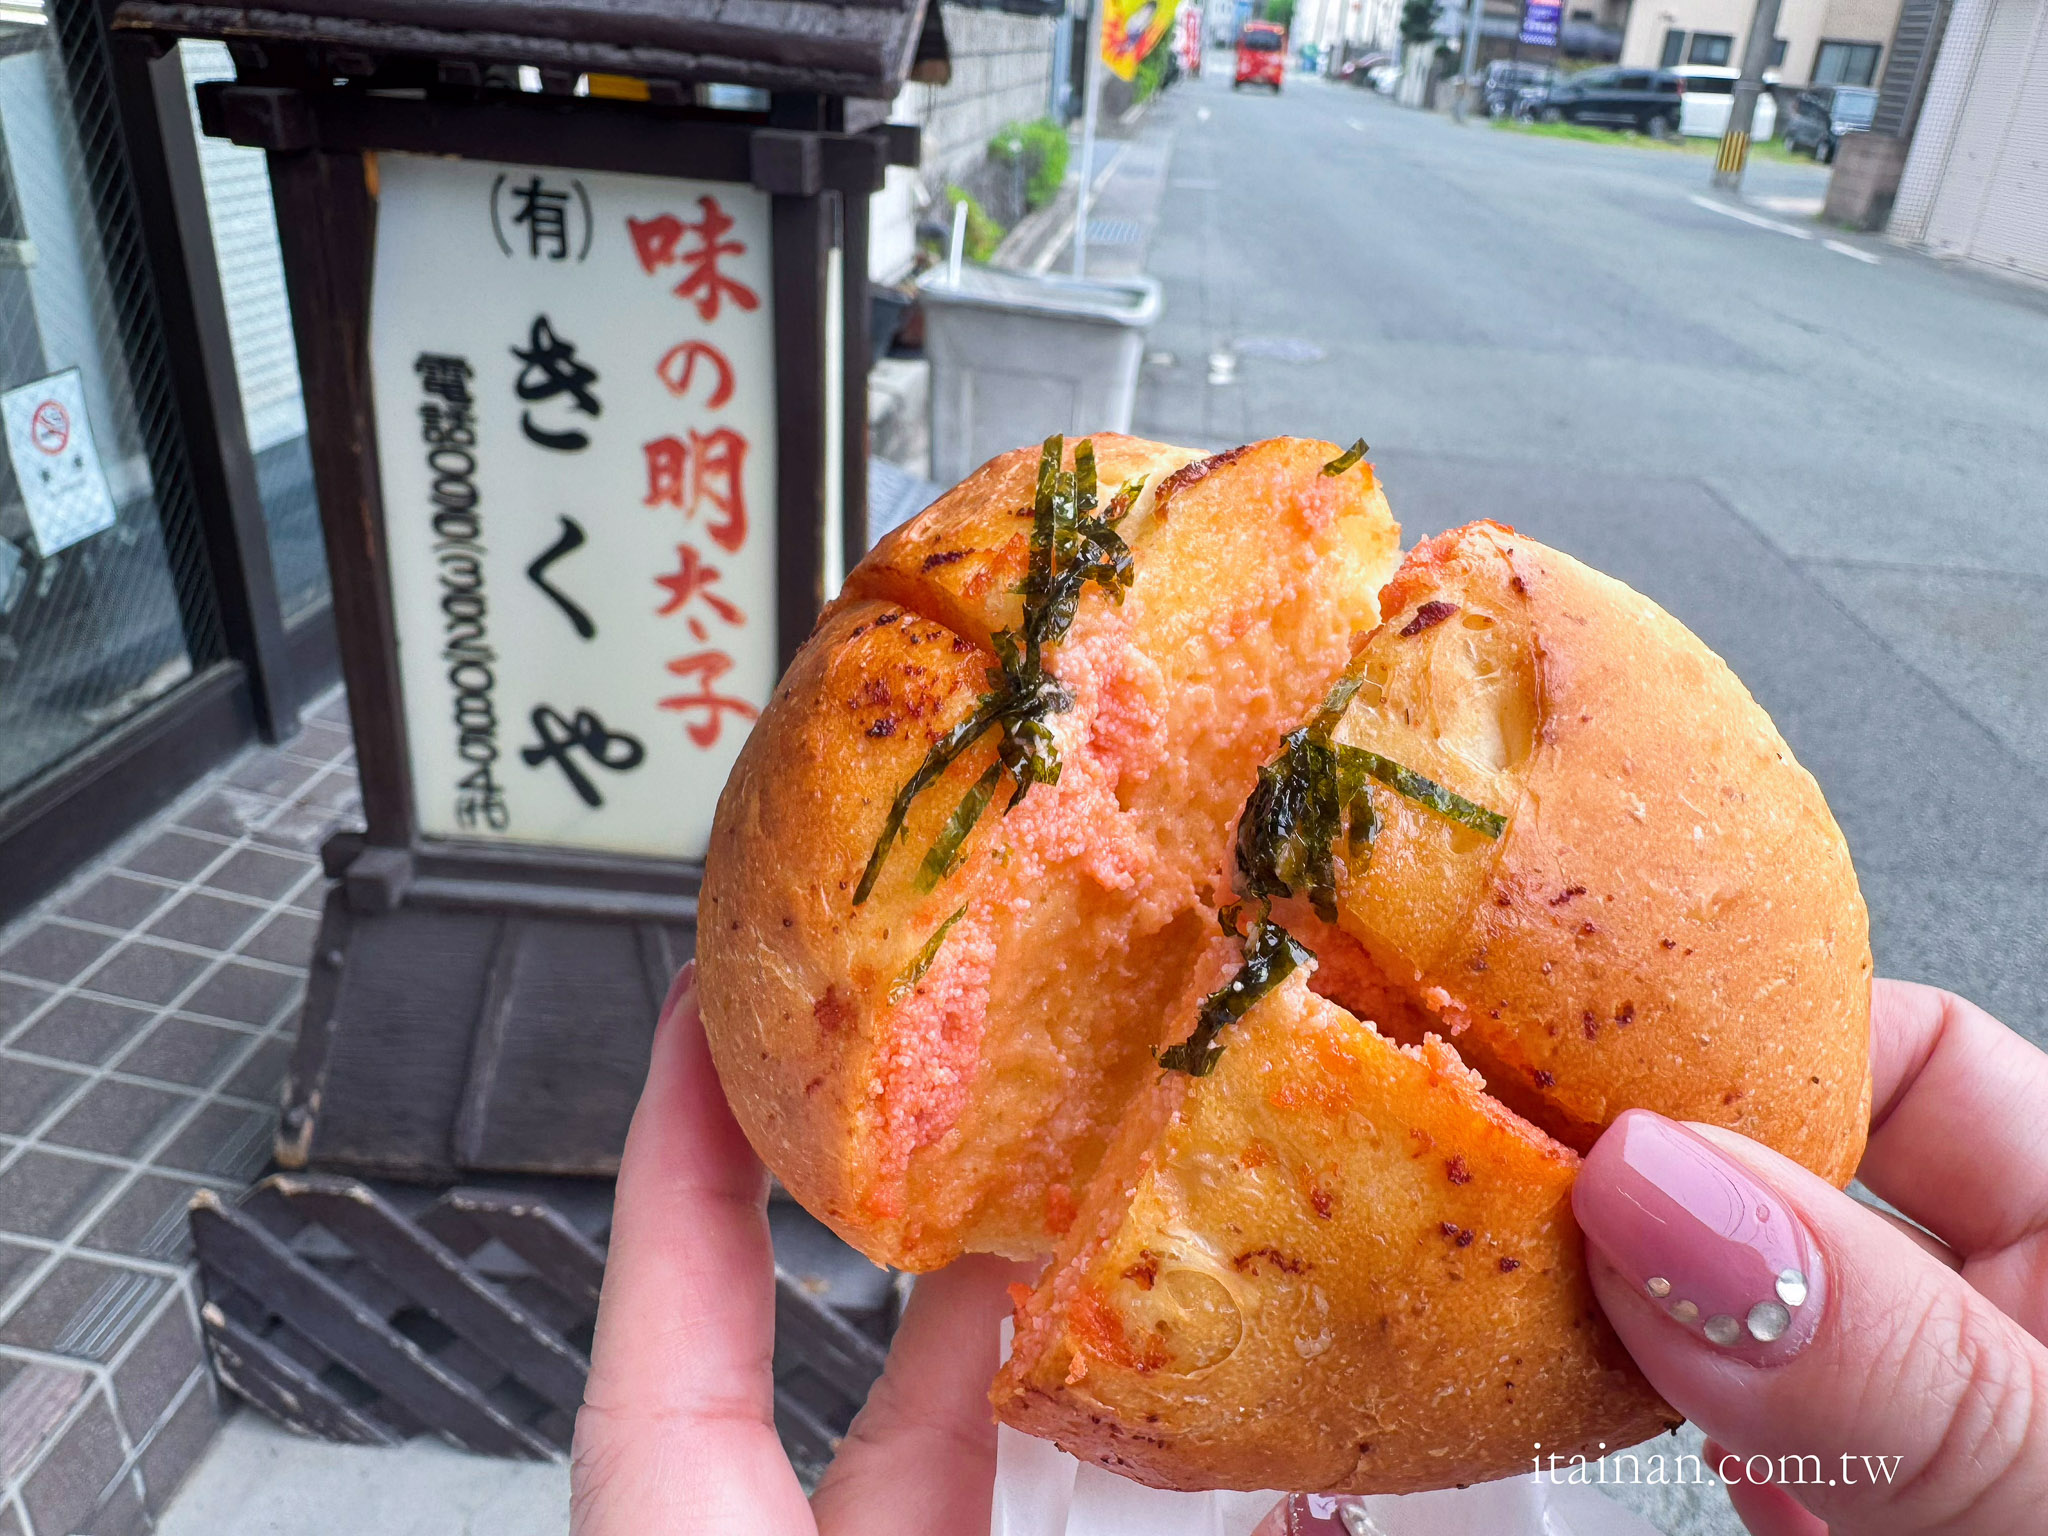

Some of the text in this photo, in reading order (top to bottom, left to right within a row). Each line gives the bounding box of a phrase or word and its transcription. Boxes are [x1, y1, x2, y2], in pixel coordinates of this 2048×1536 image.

[625, 195, 761, 749] 味の明太子
